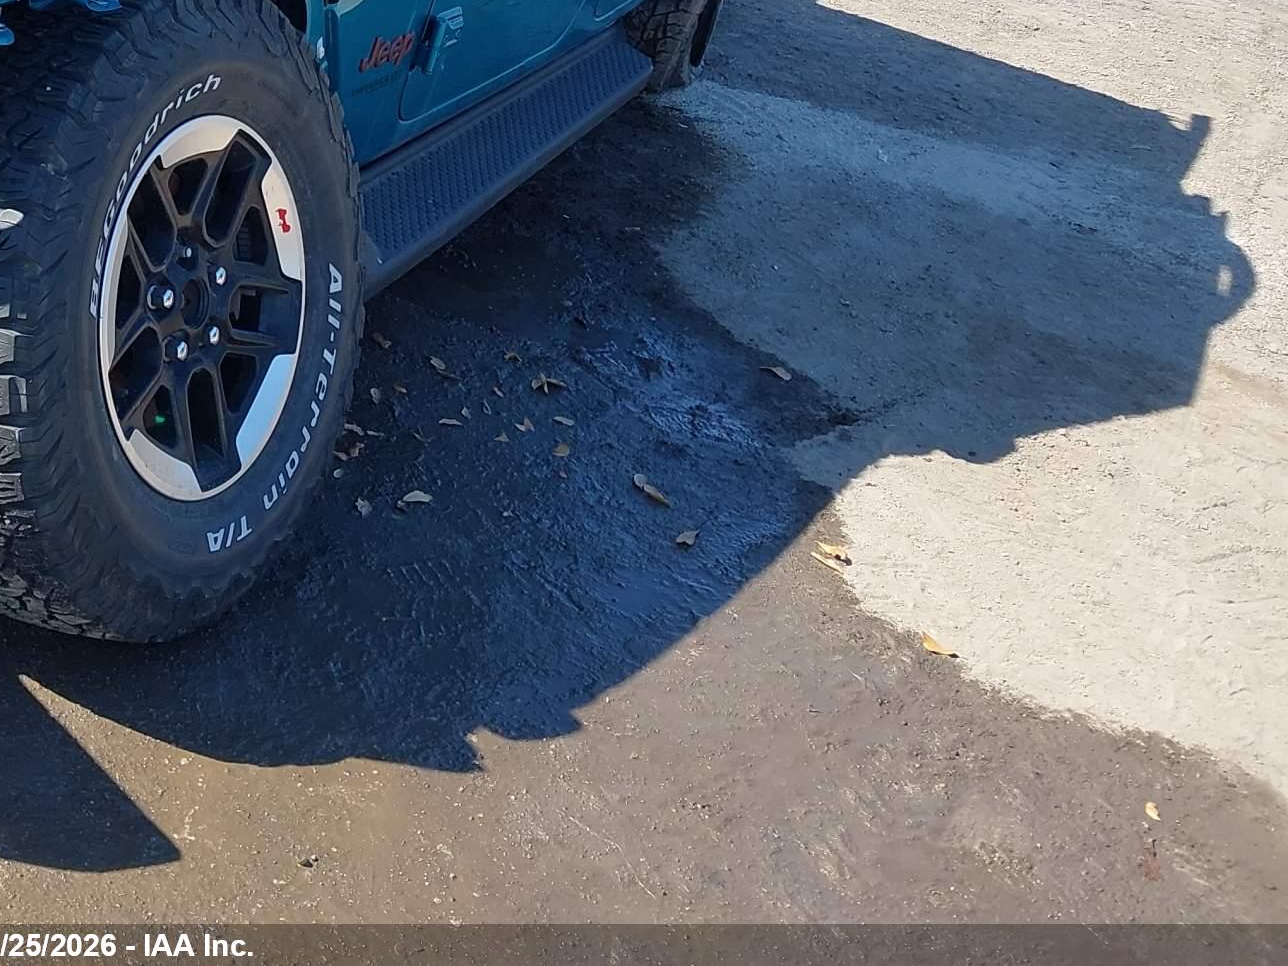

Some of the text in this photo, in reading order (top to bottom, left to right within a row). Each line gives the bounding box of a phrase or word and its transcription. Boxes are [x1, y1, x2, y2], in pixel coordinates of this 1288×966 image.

[359, 31, 415, 73] Jeep
[89, 73, 222, 319] BFGoodrich
[206, 263, 344, 553] All-Terrain T/A
